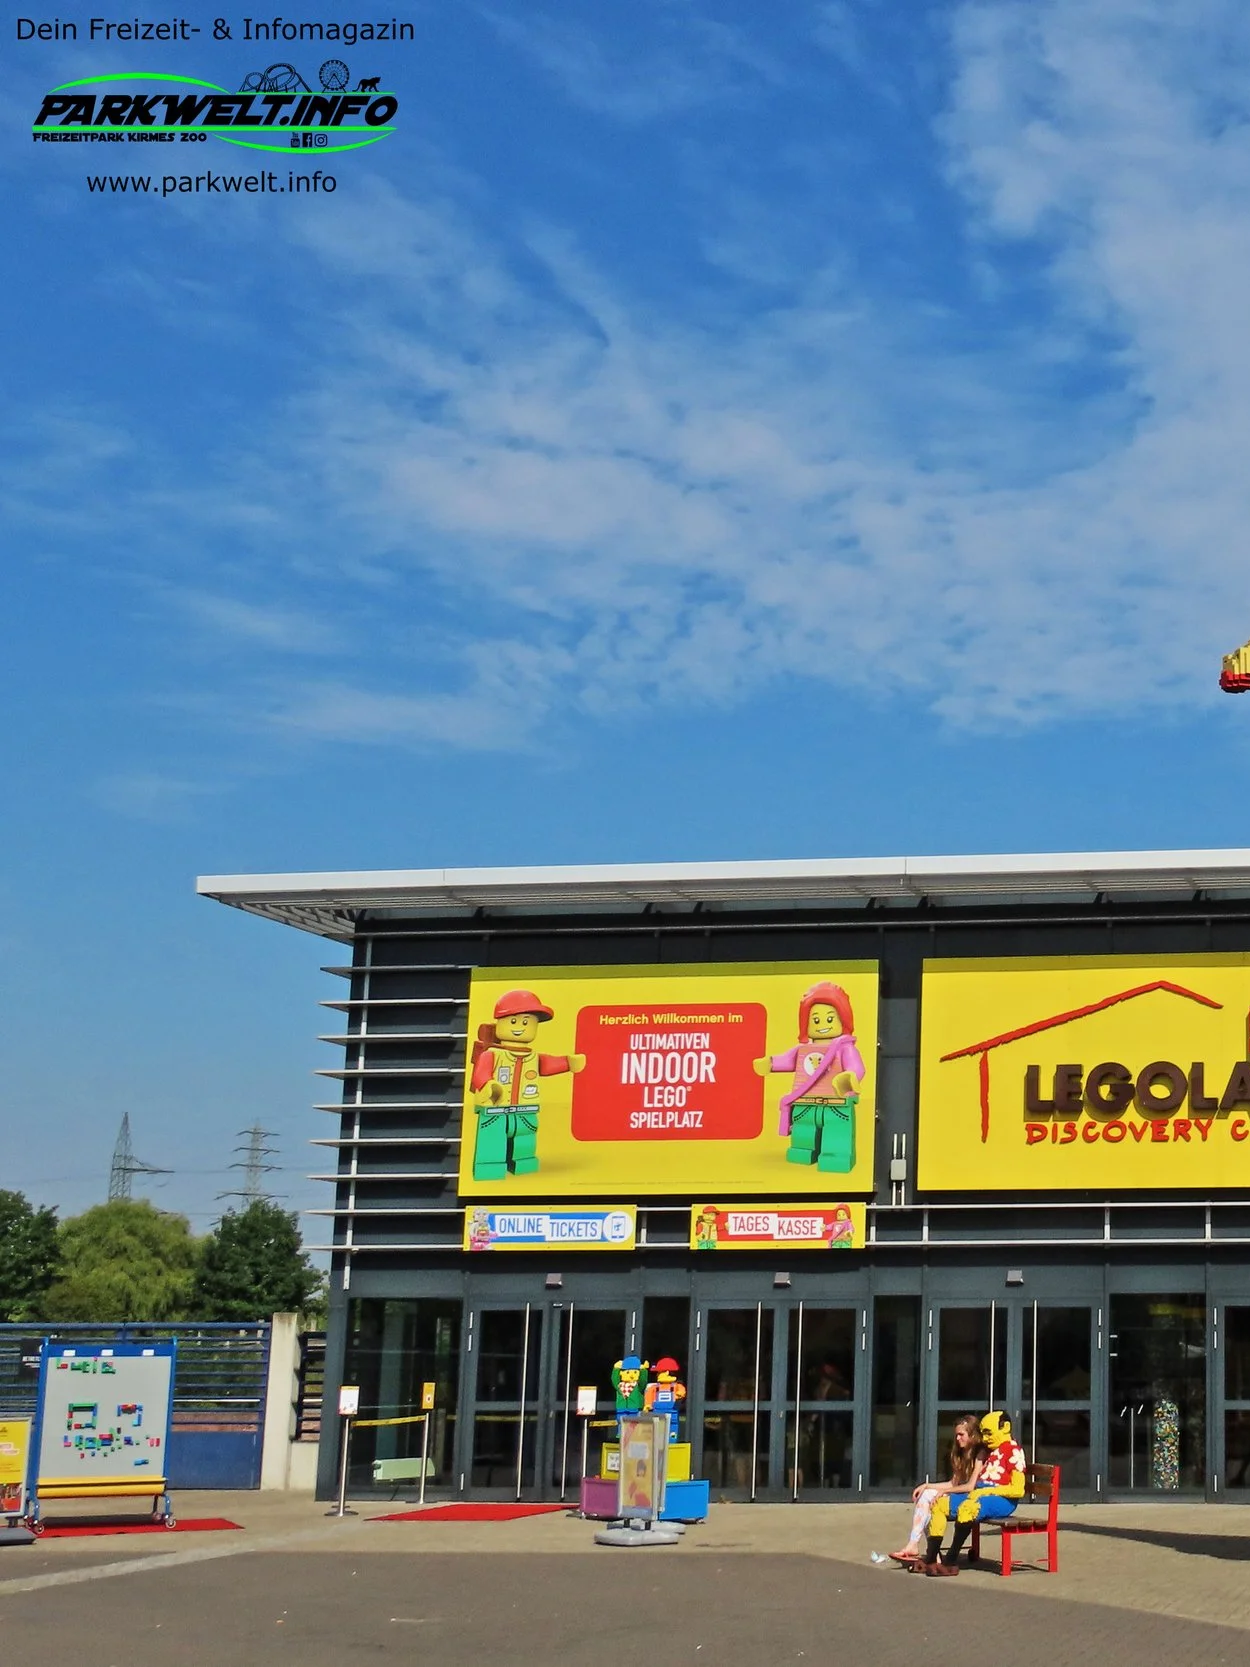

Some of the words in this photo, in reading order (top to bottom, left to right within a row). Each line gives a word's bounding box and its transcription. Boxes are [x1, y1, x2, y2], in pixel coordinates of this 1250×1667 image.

[600, 1013, 649, 1026] Herzlich
[652, 1013, 725, 1025] Willkommen
[728, 1012, 744, 1023] im
[630, 1033, 710, 1051] ULTIMATIVEN
[621, 1051, 716, 1085] INDOOR
[630, 1111, 703, 1129] SPIELPLATZ
[1025, 1118, 1213, 1145] DISCOVERY
[500, 1217, 544, 1234] ONLINE
[549, 1220, 598, 1238] TICKETS
[732, 1215, 770, 1233] TAGES
[777, 1219, 818, 1236] KASSE
